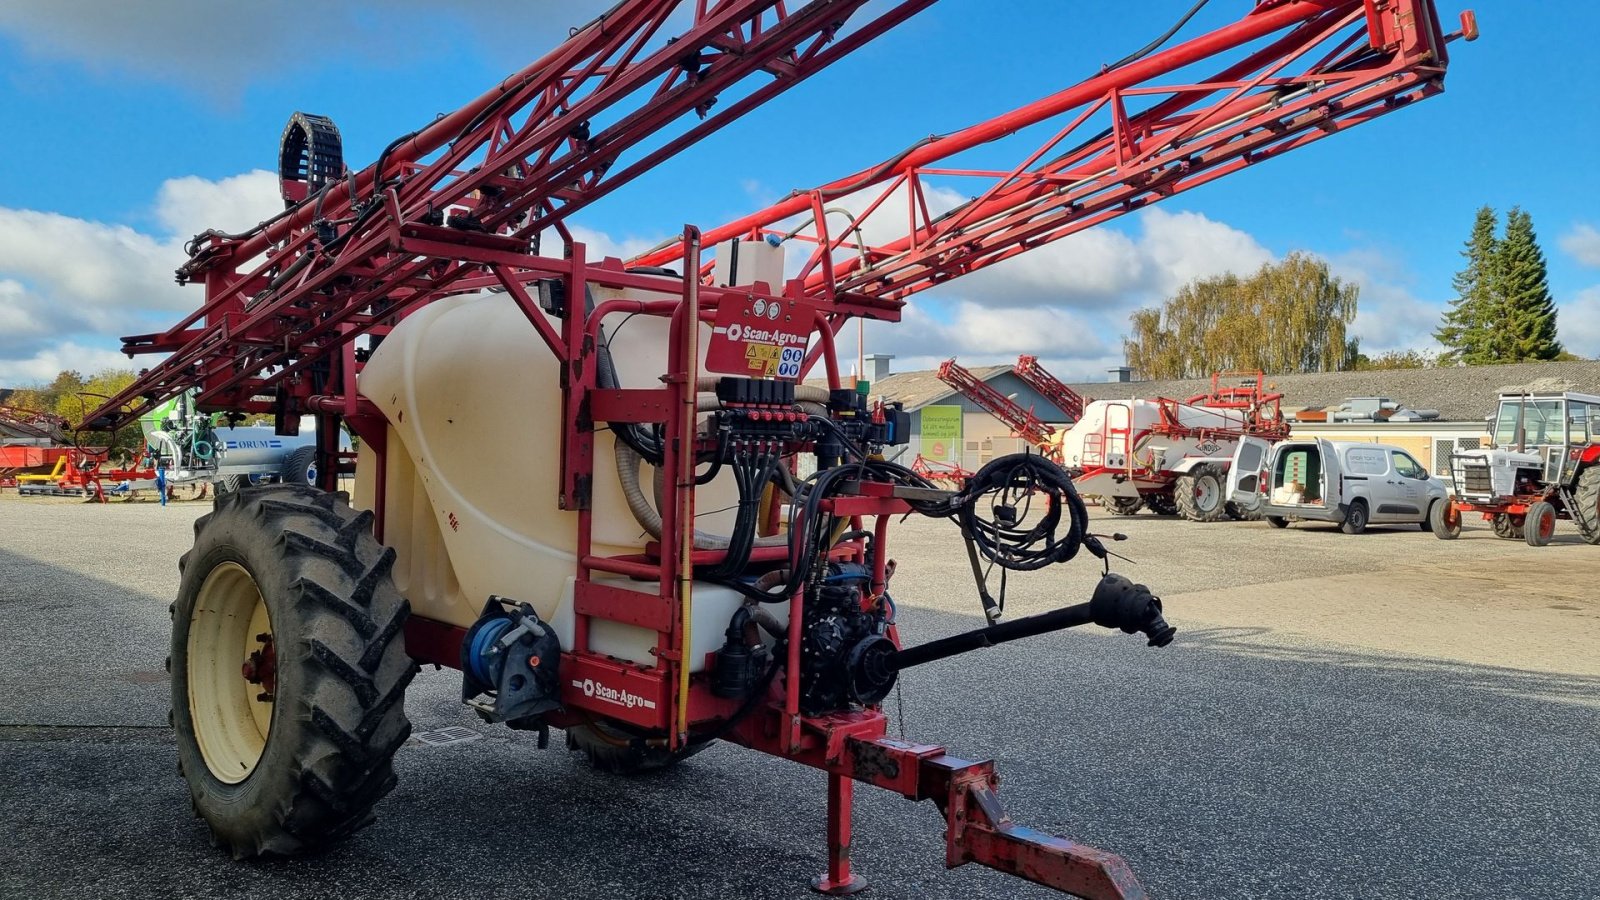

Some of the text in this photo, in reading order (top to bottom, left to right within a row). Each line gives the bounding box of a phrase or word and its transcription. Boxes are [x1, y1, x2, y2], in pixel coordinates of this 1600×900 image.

[742, 325, 797, 346] Scan-Agro
[238, 440, 268, 449] ØRUM
[595, 682, 644, 708] Scan-Agro
